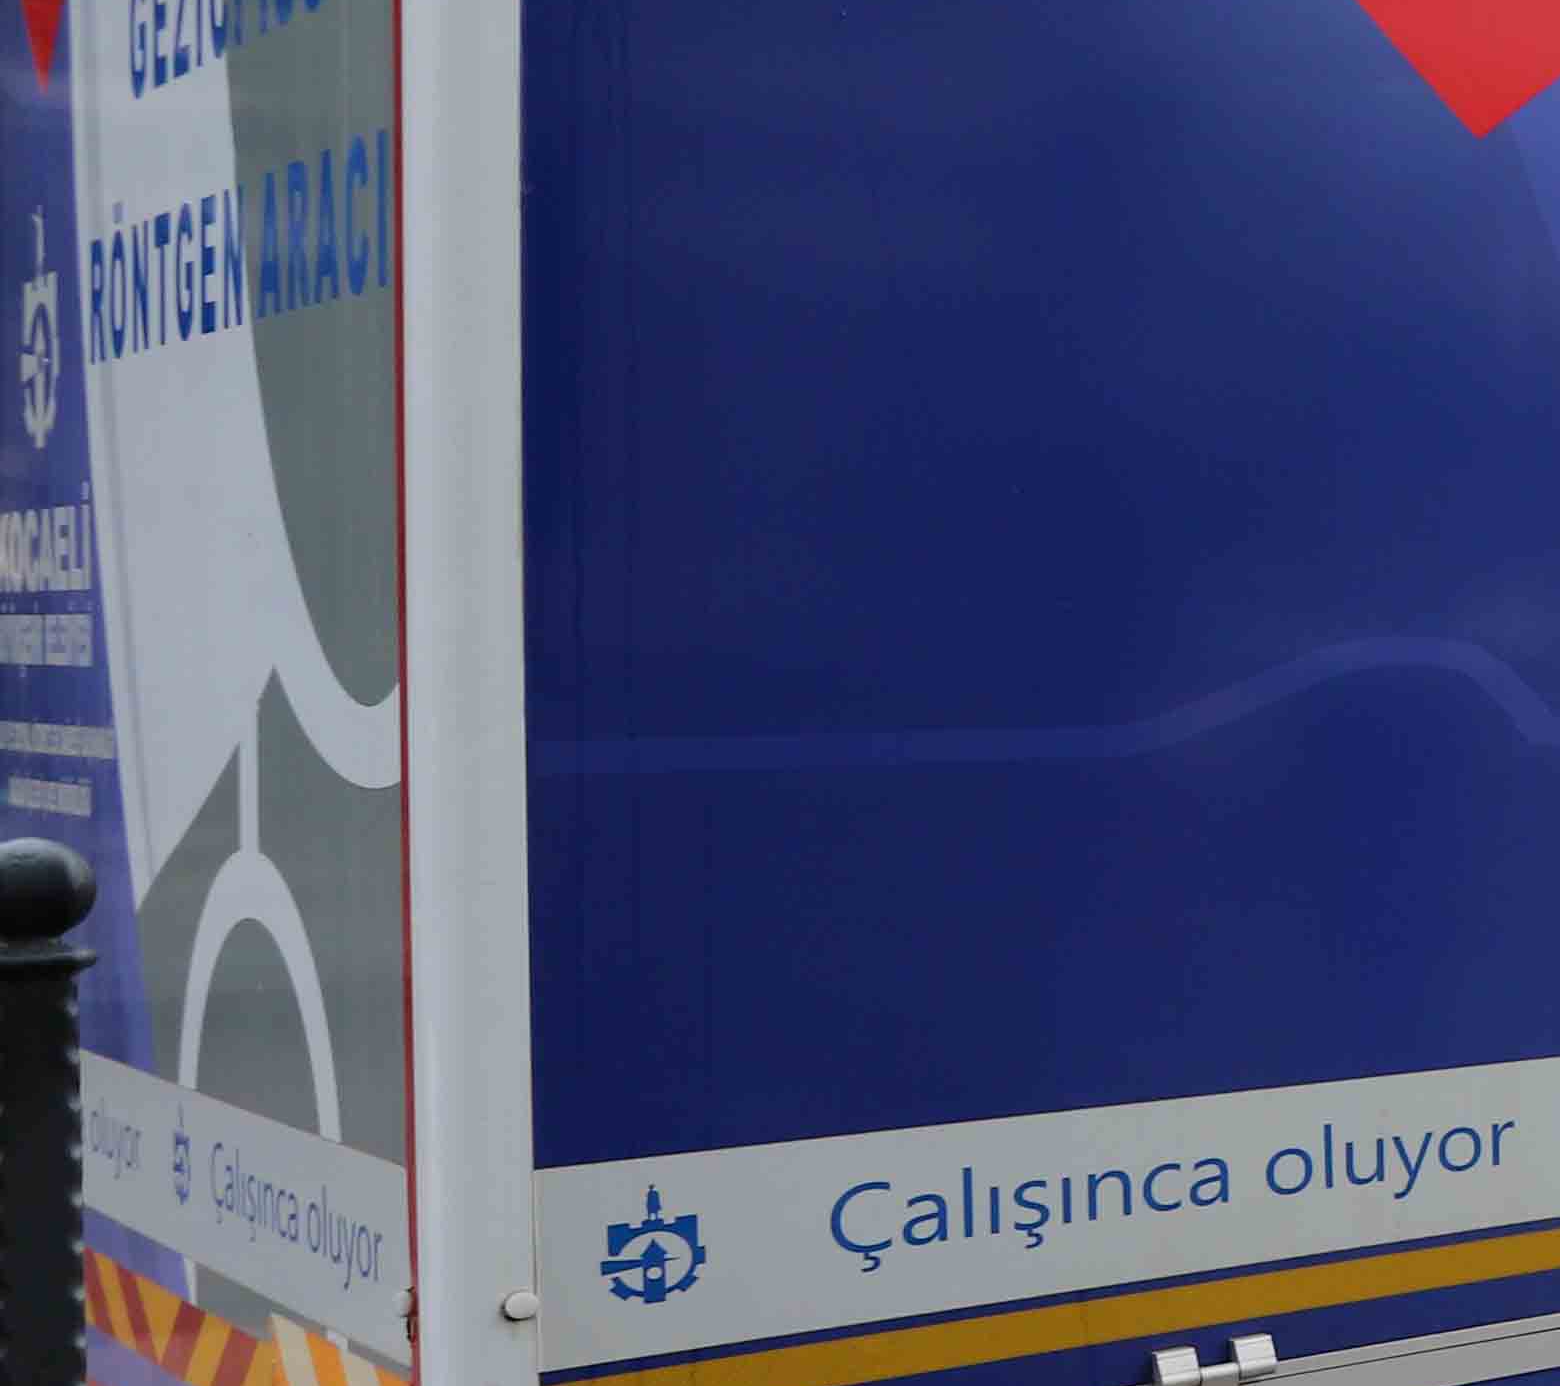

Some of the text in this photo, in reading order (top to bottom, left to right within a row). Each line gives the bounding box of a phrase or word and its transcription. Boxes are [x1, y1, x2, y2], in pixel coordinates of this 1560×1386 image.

[89, 129, 389, 365] RÖNTGEN ARACI
[209, 1141, 383, 1291] Çalışınca oluyor
[829, 1118, 1515, 1272] Çalışınca oluyor
